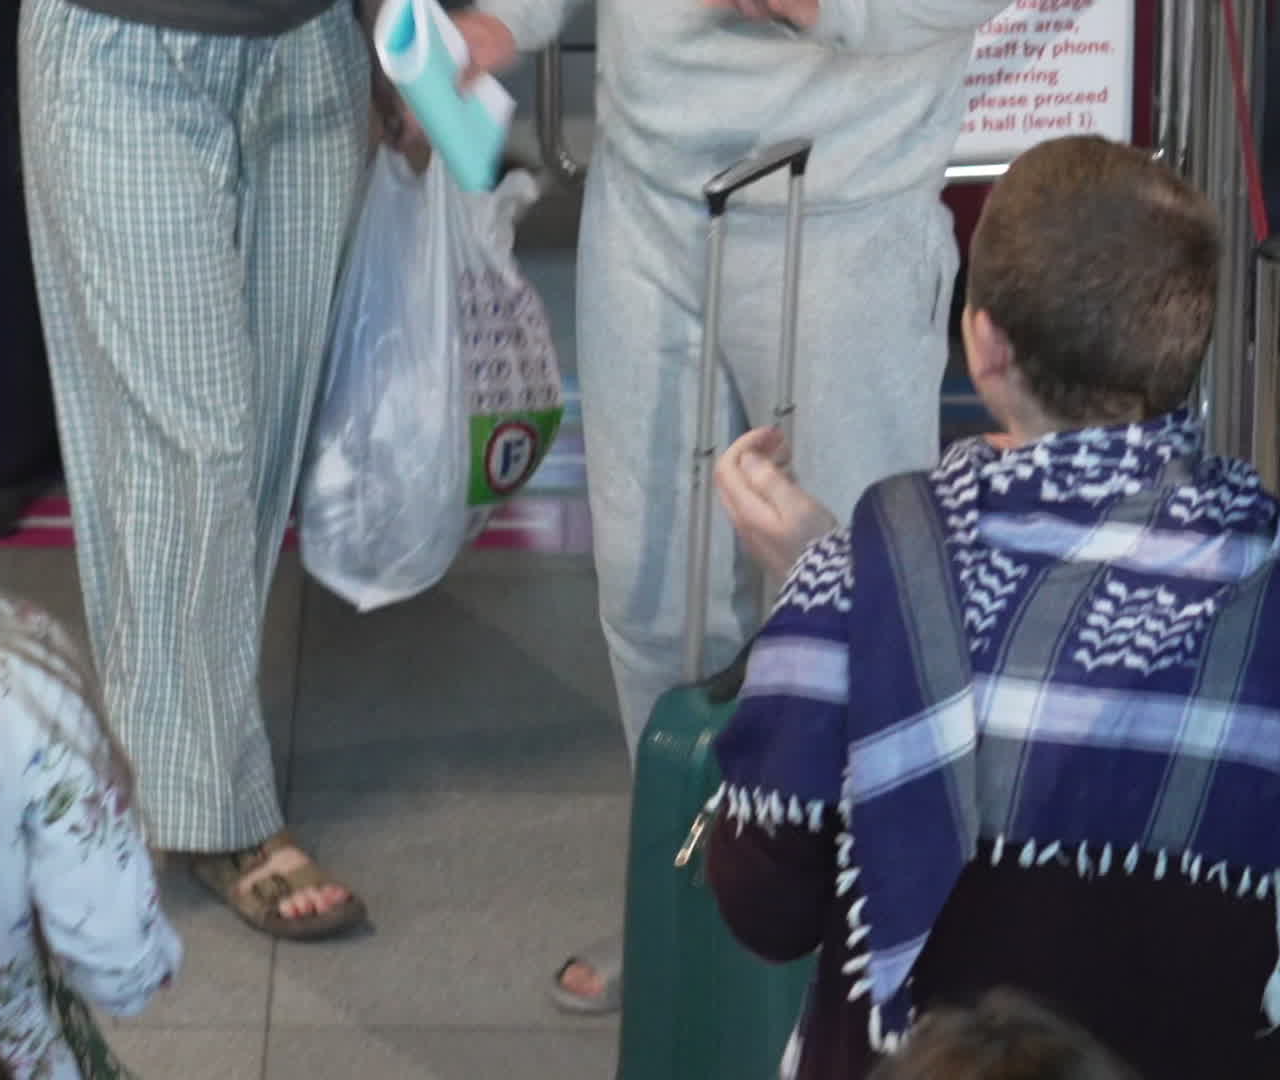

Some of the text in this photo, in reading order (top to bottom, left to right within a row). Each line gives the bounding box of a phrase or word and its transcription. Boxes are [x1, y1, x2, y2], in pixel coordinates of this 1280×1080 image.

[1023, 40, 1046, 58] by
[964, 67, 1059, 87] ansferring
[969, 86, 1109, 113] please proceed
[982, 114, 1016, 131] hall
